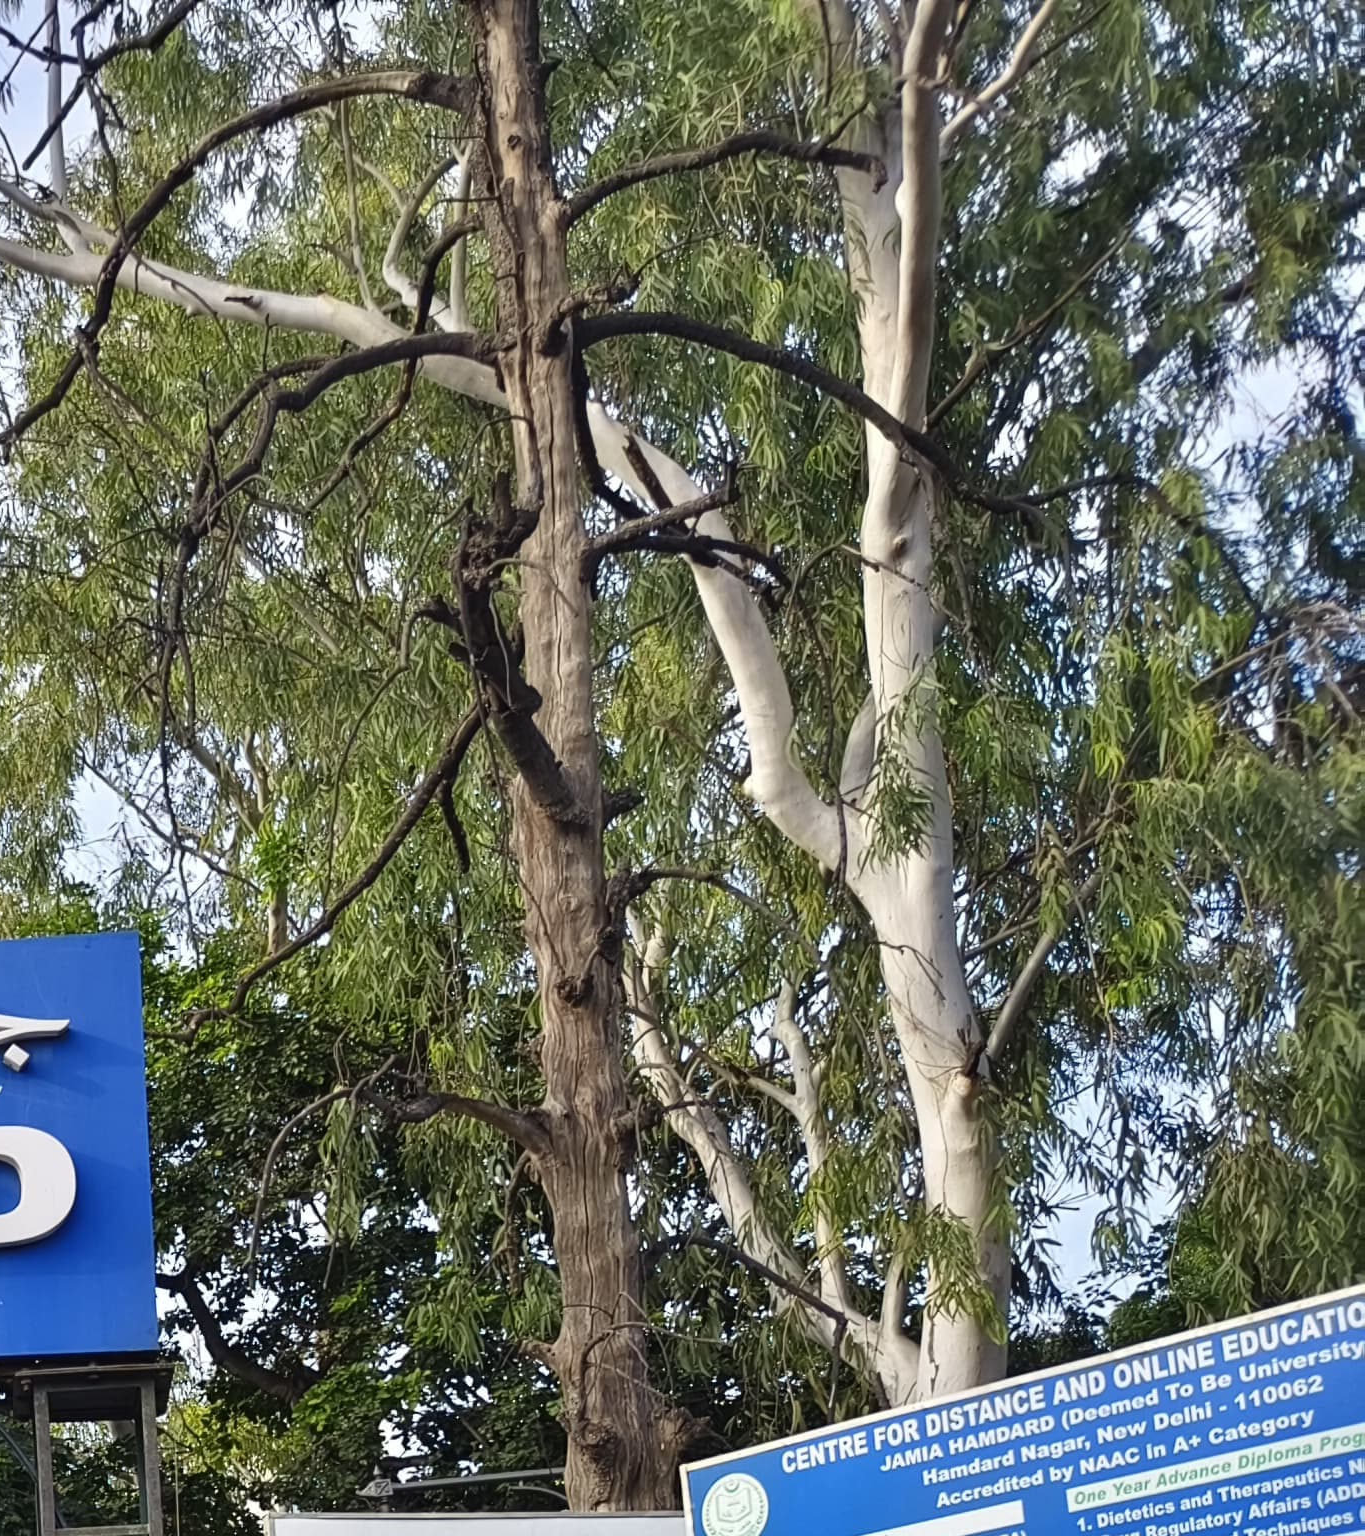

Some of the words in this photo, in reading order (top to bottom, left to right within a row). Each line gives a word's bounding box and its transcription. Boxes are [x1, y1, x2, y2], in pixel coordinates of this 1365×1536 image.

[782, 1431, 868, 1472] CENTRE
[873, 1418, 920, 1450] FOR
[925, 1384, 1045, 1436] DISTANCE
[1053, 1370, 1105, 1405] AND
[1113, 1340, 1214, 1387] ONLINE
[880, 1443, 943, 1471] JAMIA
[948, 1415, 1054, 1454] HAMDARD
[1061, 1388, 1158, 1430] (Deemed
[1164, 1382, 1193, 1400] To
[1200, 1374, 1232, 1392] Be
[922, 1449, 1014, 1485] Hamdard
[1020, 1435, 1090, 1462] Nagar,
[1096, 1421, 1146, 1444] New
[1153, 1401, 1212, 1430] Delhi
[1234, 1374, 1323, 1410] 110062
[936, 1469, 1043, 1507] Accredited
[1049, 1465, 1073, 1482] by
[1079, 1447, 1140, 1474] NAAC
[1146, 1443, 1166, 1459] in
[1173, 1435, 1201, 1453] A+
[1208, 1409, 1313, 1444] Category
